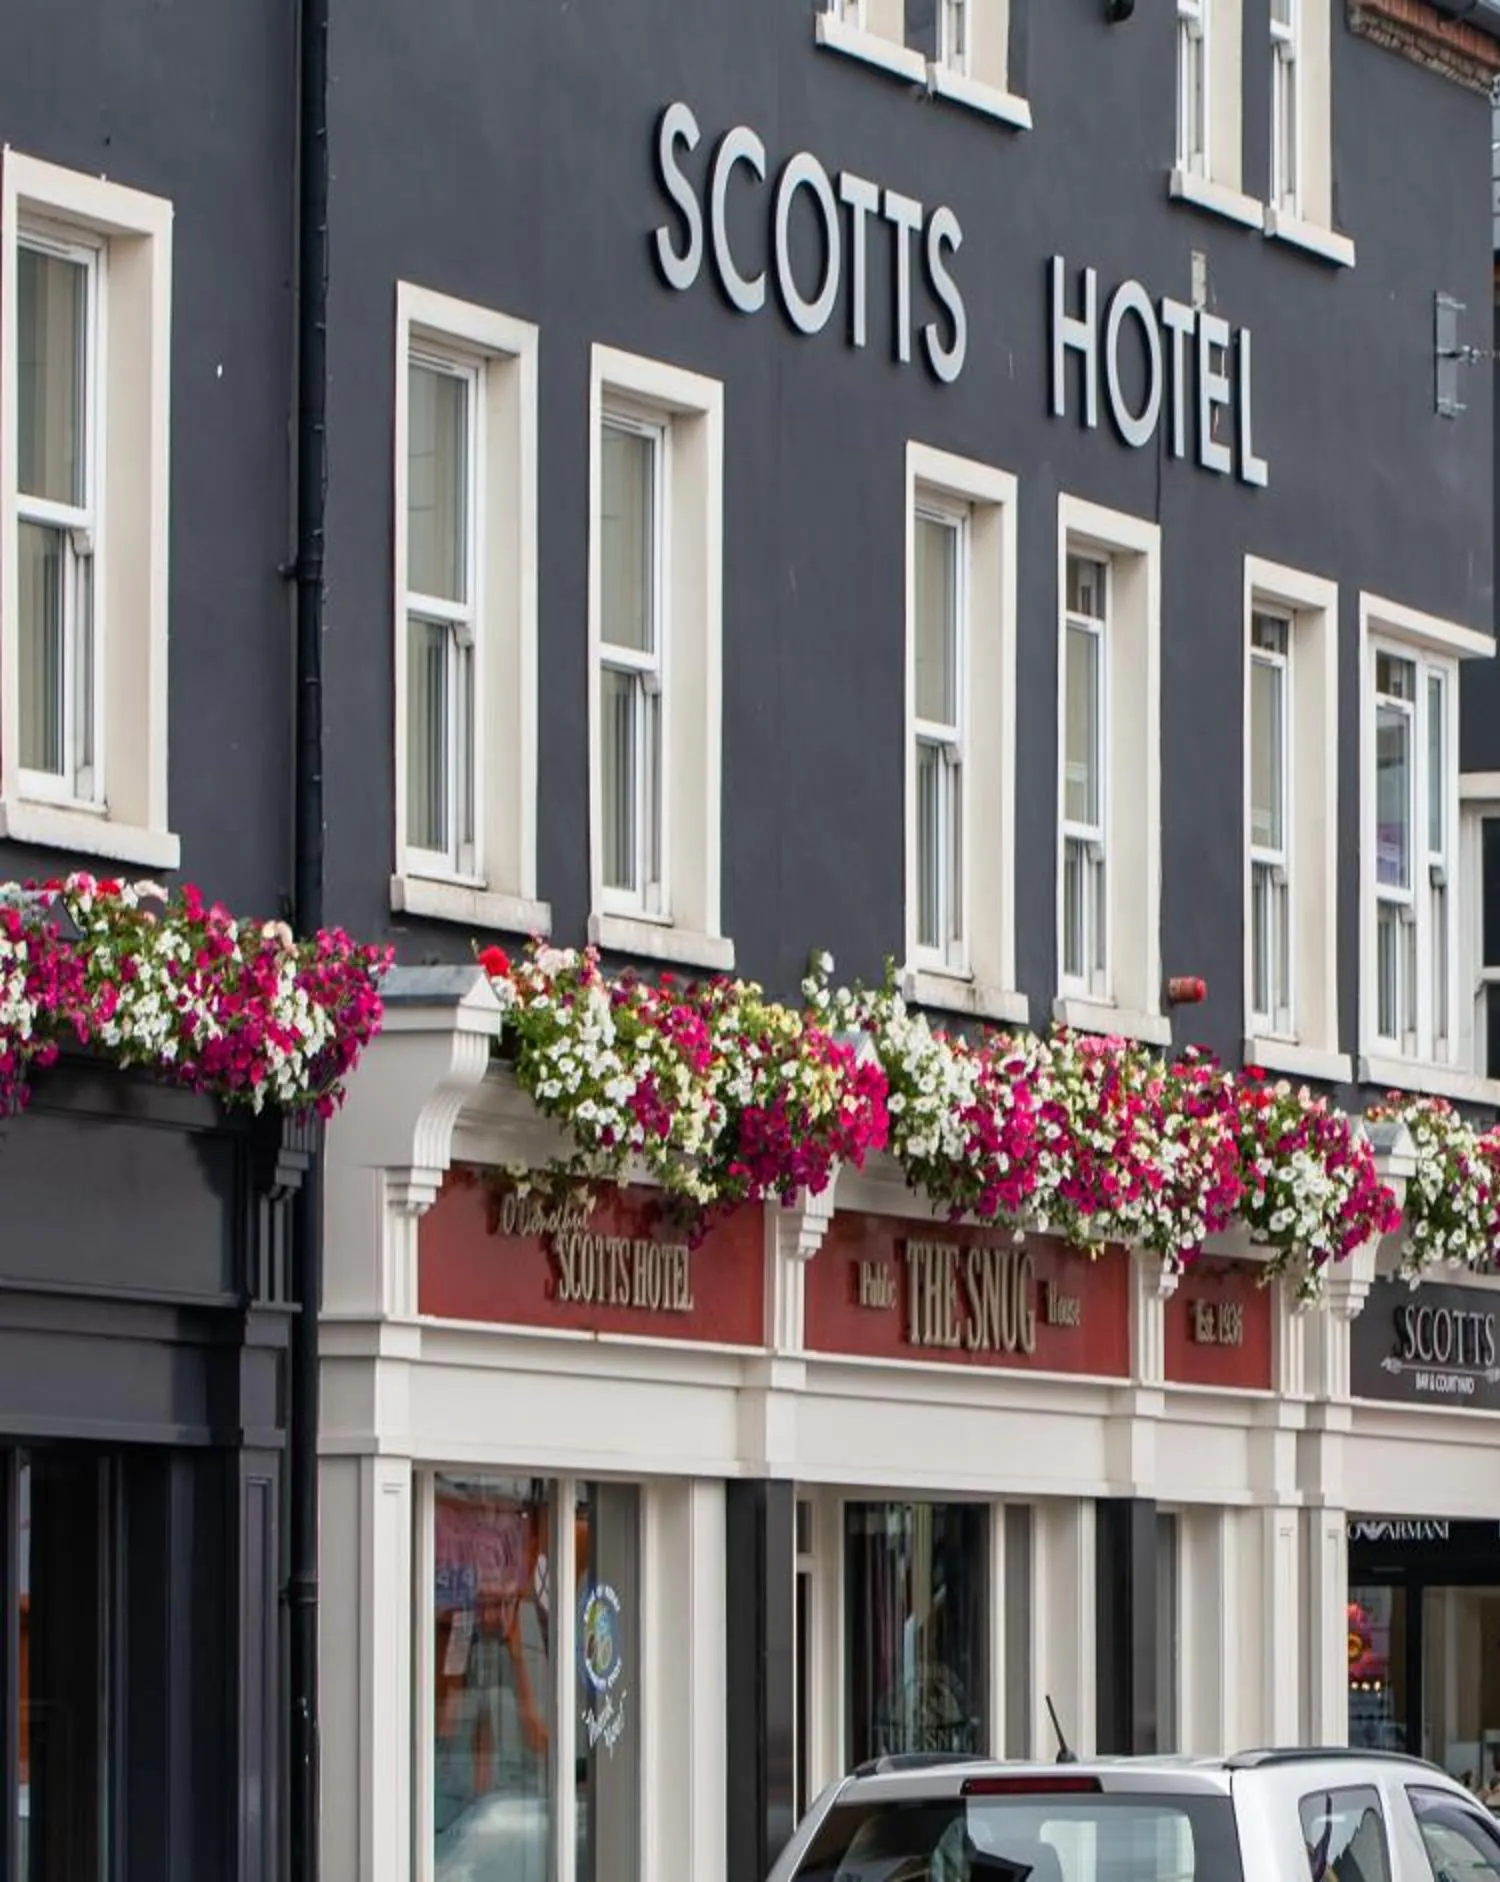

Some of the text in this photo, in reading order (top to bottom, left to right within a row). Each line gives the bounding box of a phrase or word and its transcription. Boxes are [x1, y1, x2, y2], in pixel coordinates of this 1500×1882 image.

[652, 101, 1269, 488] SCOTTS HOTEL
[556, 1234, 694, 1311] SCOTTS HOTEL
[906, 1238, 1036, 1355] THE SNUG
[1404, 1304, 1495, 1366] SCOTTS
